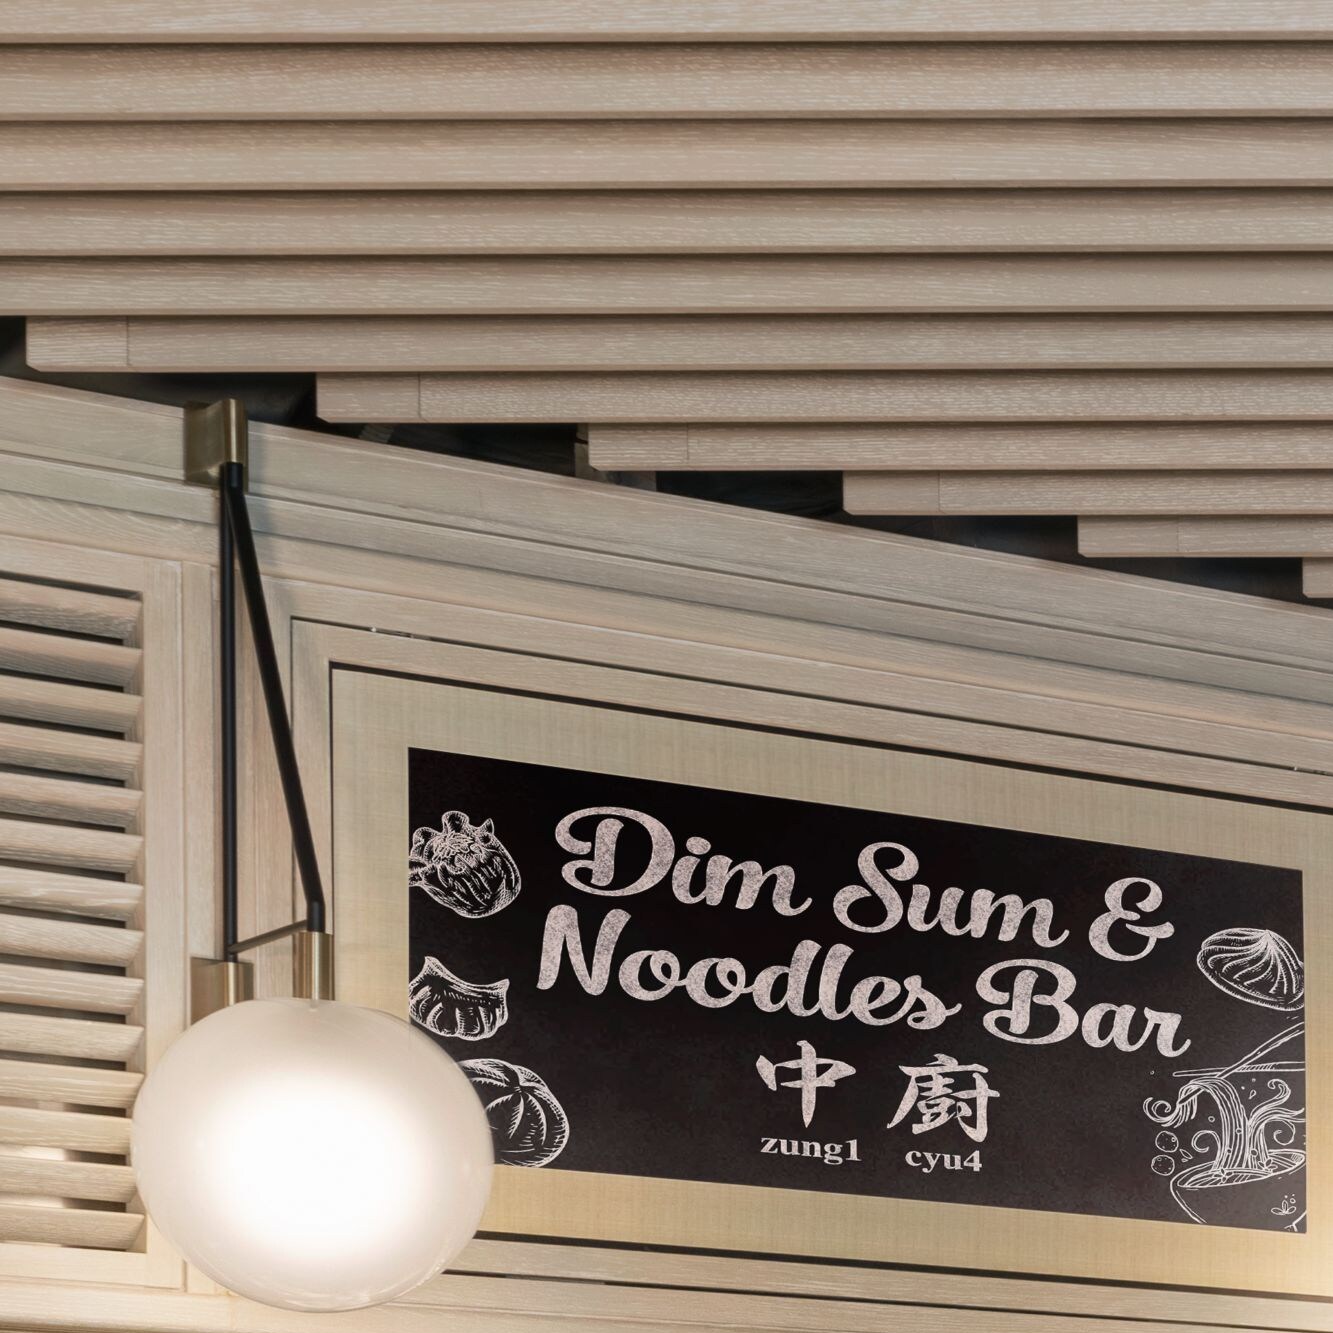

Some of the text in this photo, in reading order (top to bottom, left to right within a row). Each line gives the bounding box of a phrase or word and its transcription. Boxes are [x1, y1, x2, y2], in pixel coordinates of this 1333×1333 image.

[554, 806, 1175, 962] Dim Sum &
[536, 904, 1191, 1058] Noodles Bar
[760, 1137, 983, 1174] zung1 cyu4
